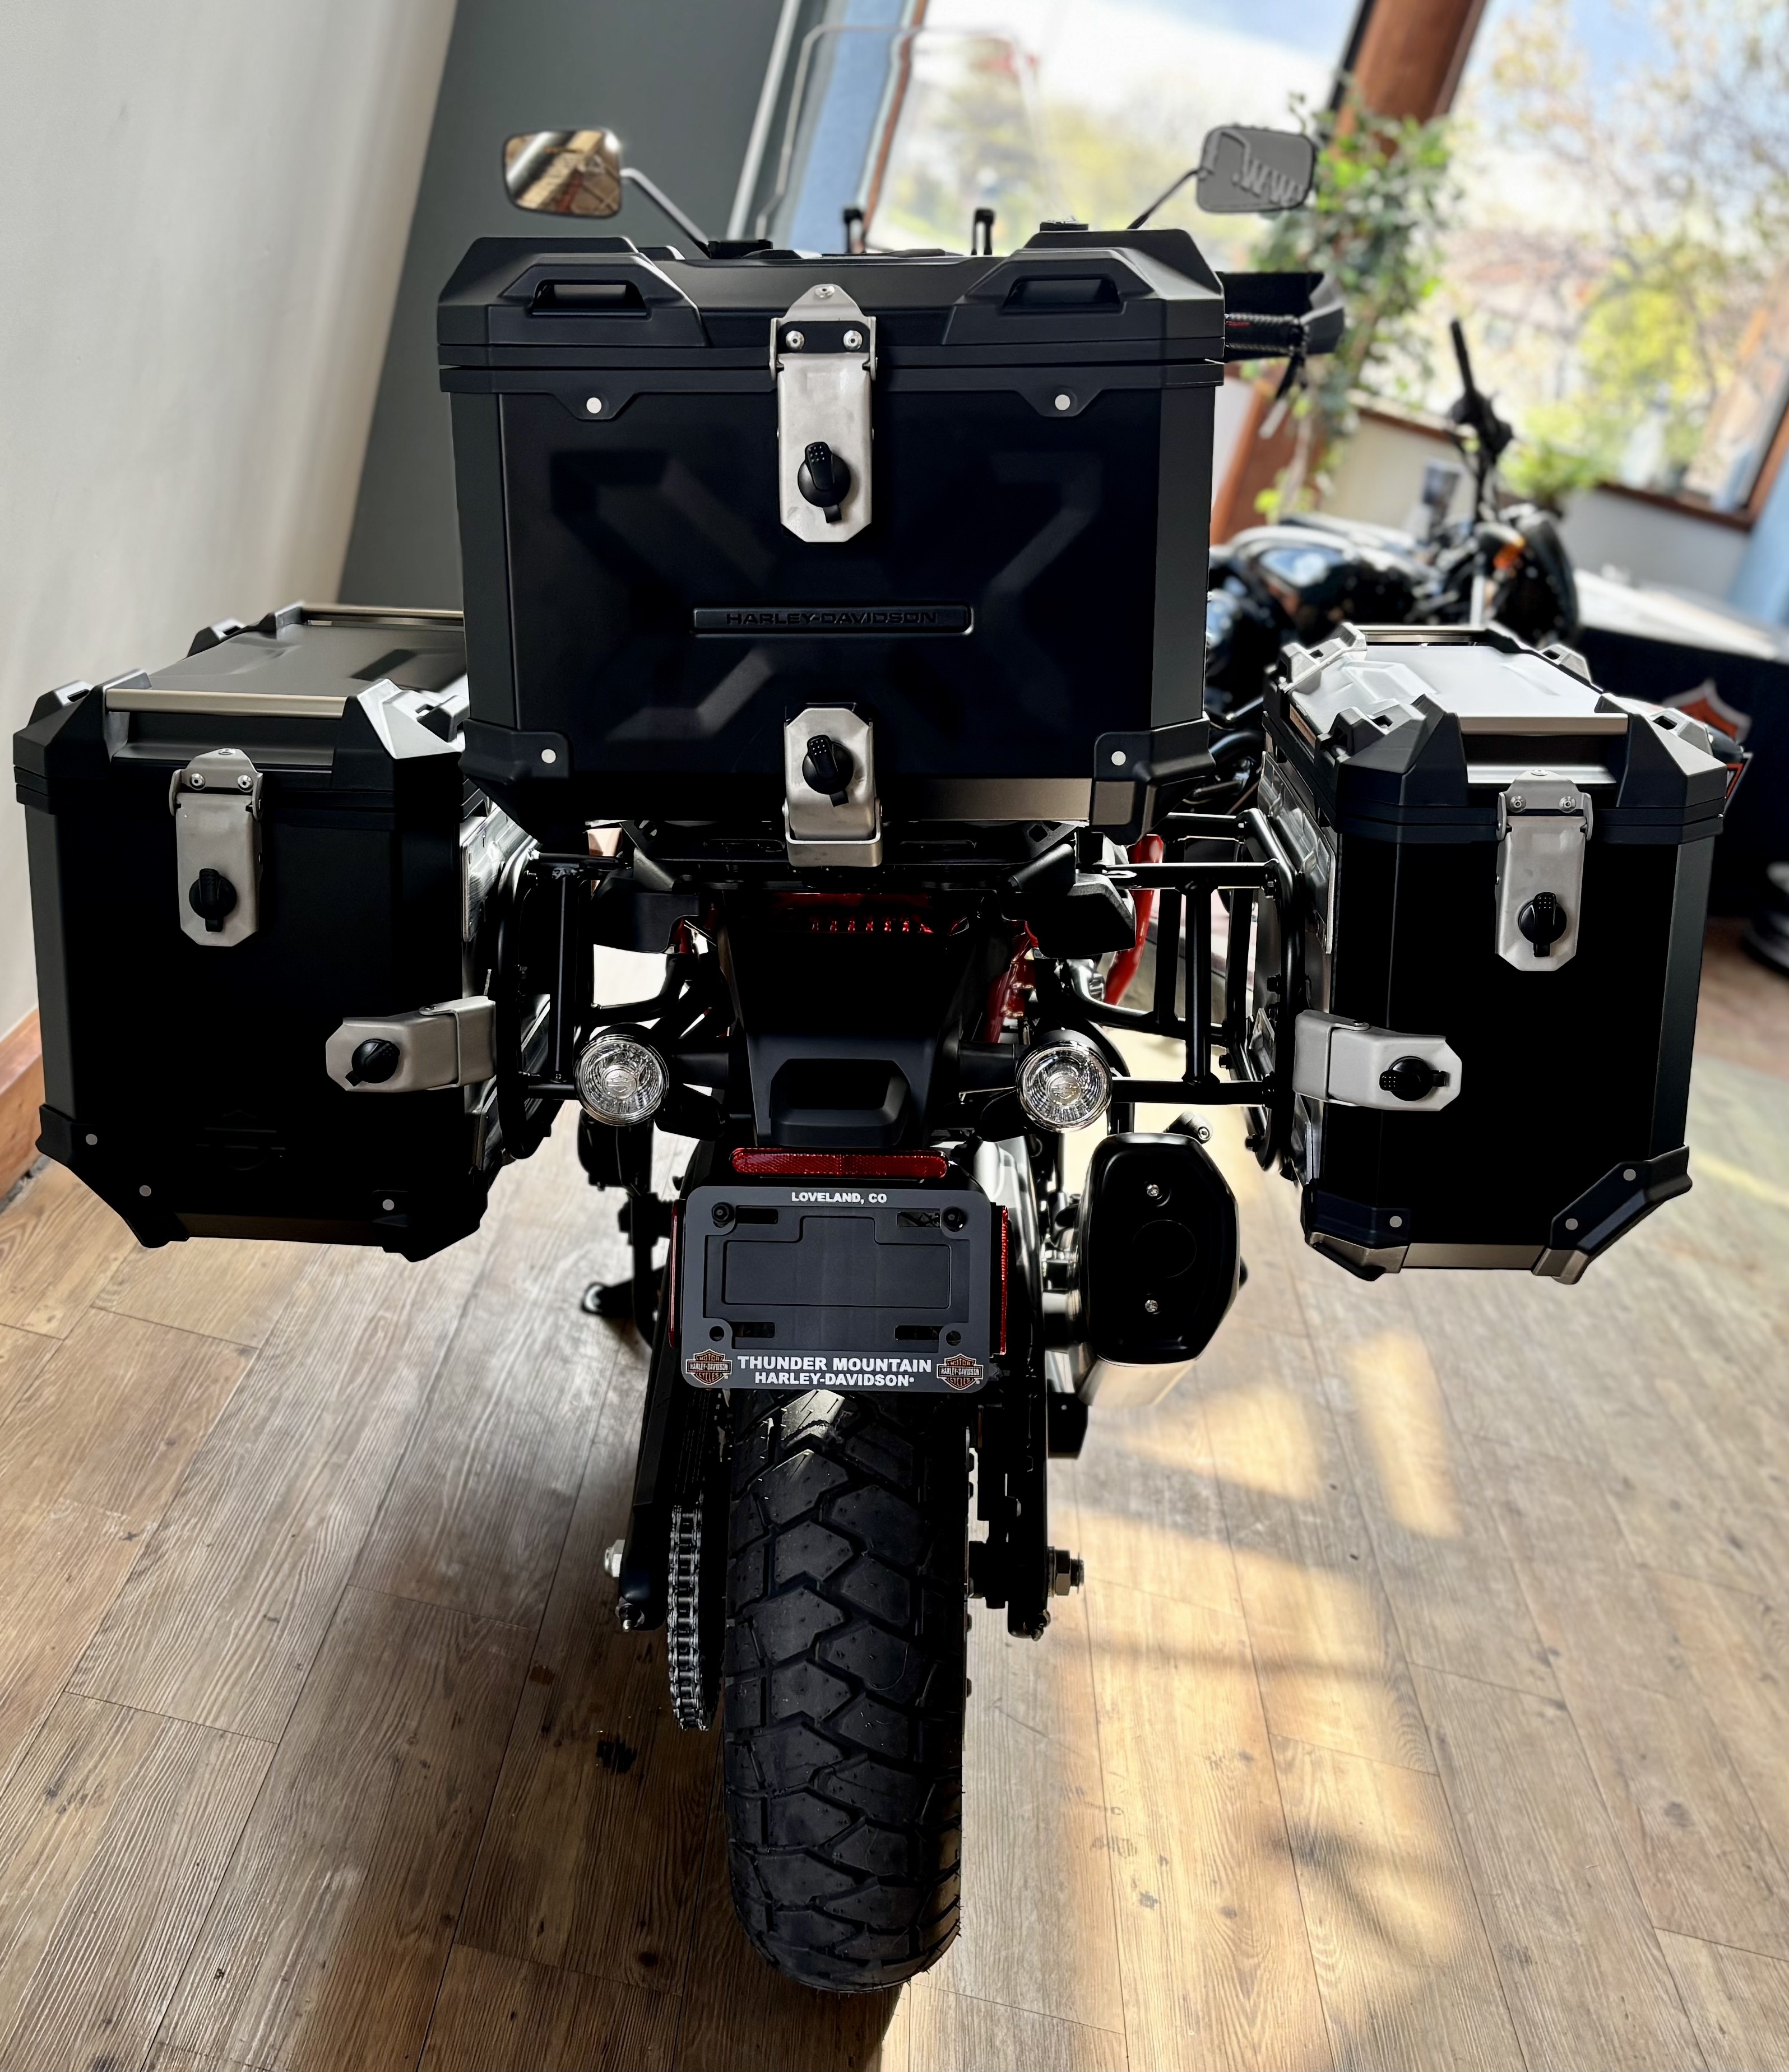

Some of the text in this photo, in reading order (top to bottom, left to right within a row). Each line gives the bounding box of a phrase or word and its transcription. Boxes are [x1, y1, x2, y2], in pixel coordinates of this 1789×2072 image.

[726, 611, 937, 624] HARLEY-DAVIDSON
[791, 1192, 887, 1204] LOVELAND, CO
[737, 1355, 932, 1373] THUNDER MOUNTAIN
